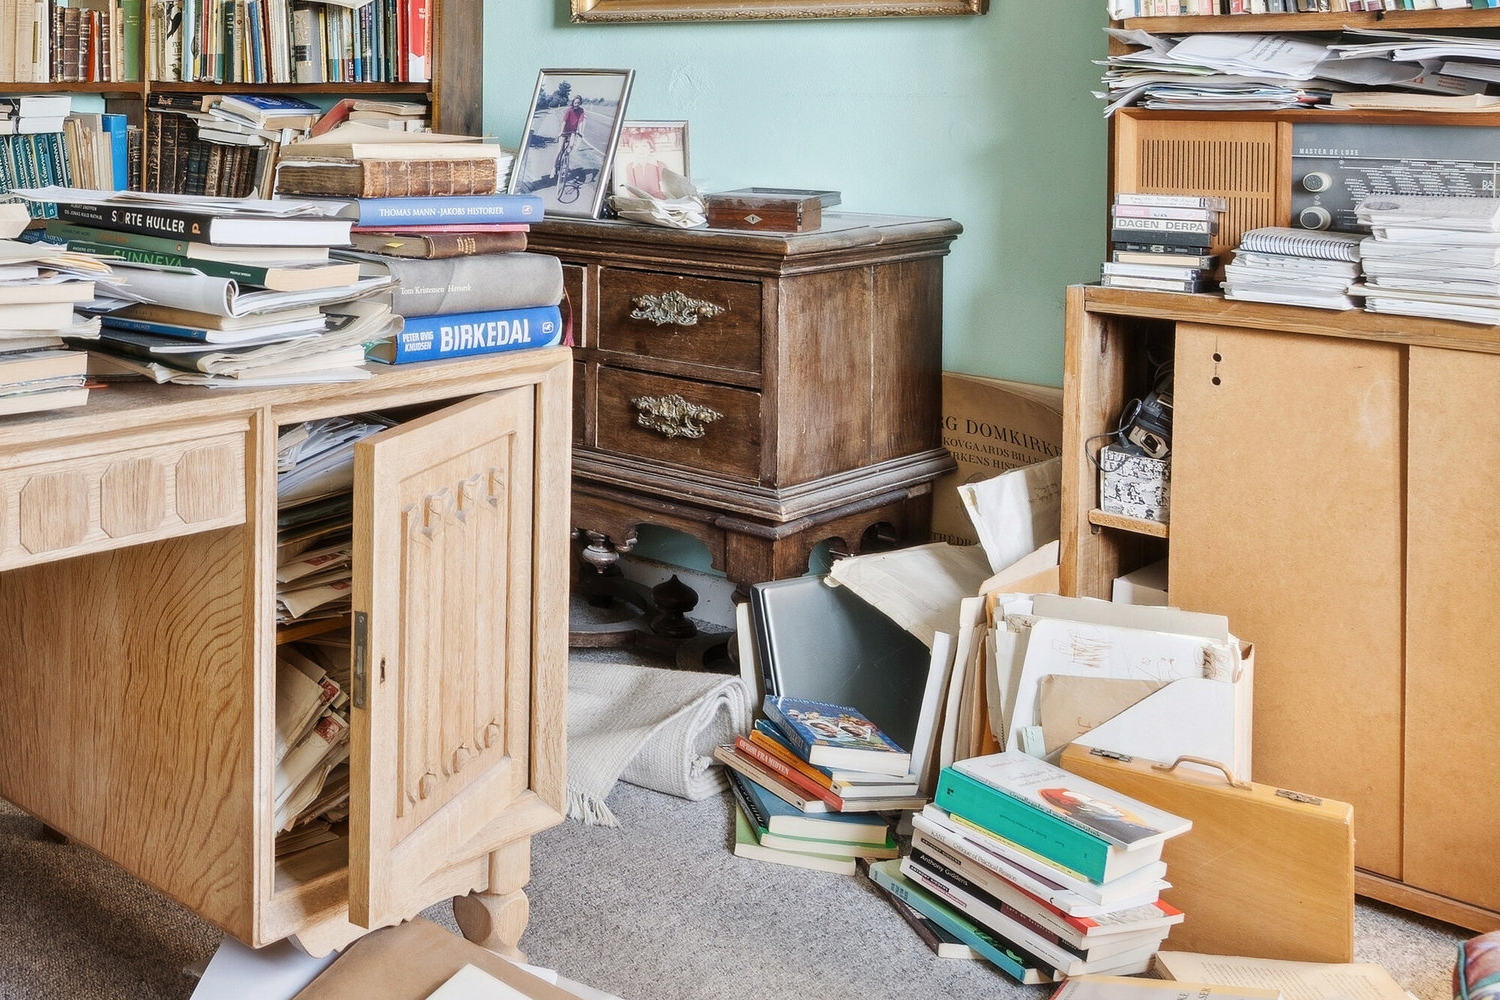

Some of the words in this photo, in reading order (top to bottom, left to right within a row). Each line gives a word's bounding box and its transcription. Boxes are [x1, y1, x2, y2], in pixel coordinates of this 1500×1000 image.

[380, 208, 411, 216] THOMAS
[412, 208, 436, 216] MANN
[440, 207, 466, 216] JAKOBS
[467, 207, 504, 215] HISTORIER
[111, 210, 143, 227] SORTE
[146, 215, 185, 233] HULLER
[1118, 219, 1159, 229] DAGEN
[400, 287, 414, 295] Tom
[415, 286, 445, 294] Kristensen
[402, 333, 420, 343] PETER
[420, 331, 434, 340] ØVIG
[440, 319, 531, 352] BIRKEDAL
[405, 342, 432, 352] KNUDSEN
[951, 452, 990, 466] RKENS
[756, 748, 768, 761] FRA
[768, 754, 790, 775] MIDTEN
[929, 829, 947, 843] KANT
[951, 840, 972, 857] Critique
[976, 854, 999, 871] Practical
[997, 866, 1018, 882] Reason
[920, 854, 944, 873] Anthony
[944, 868, 968, 886] Giddens
